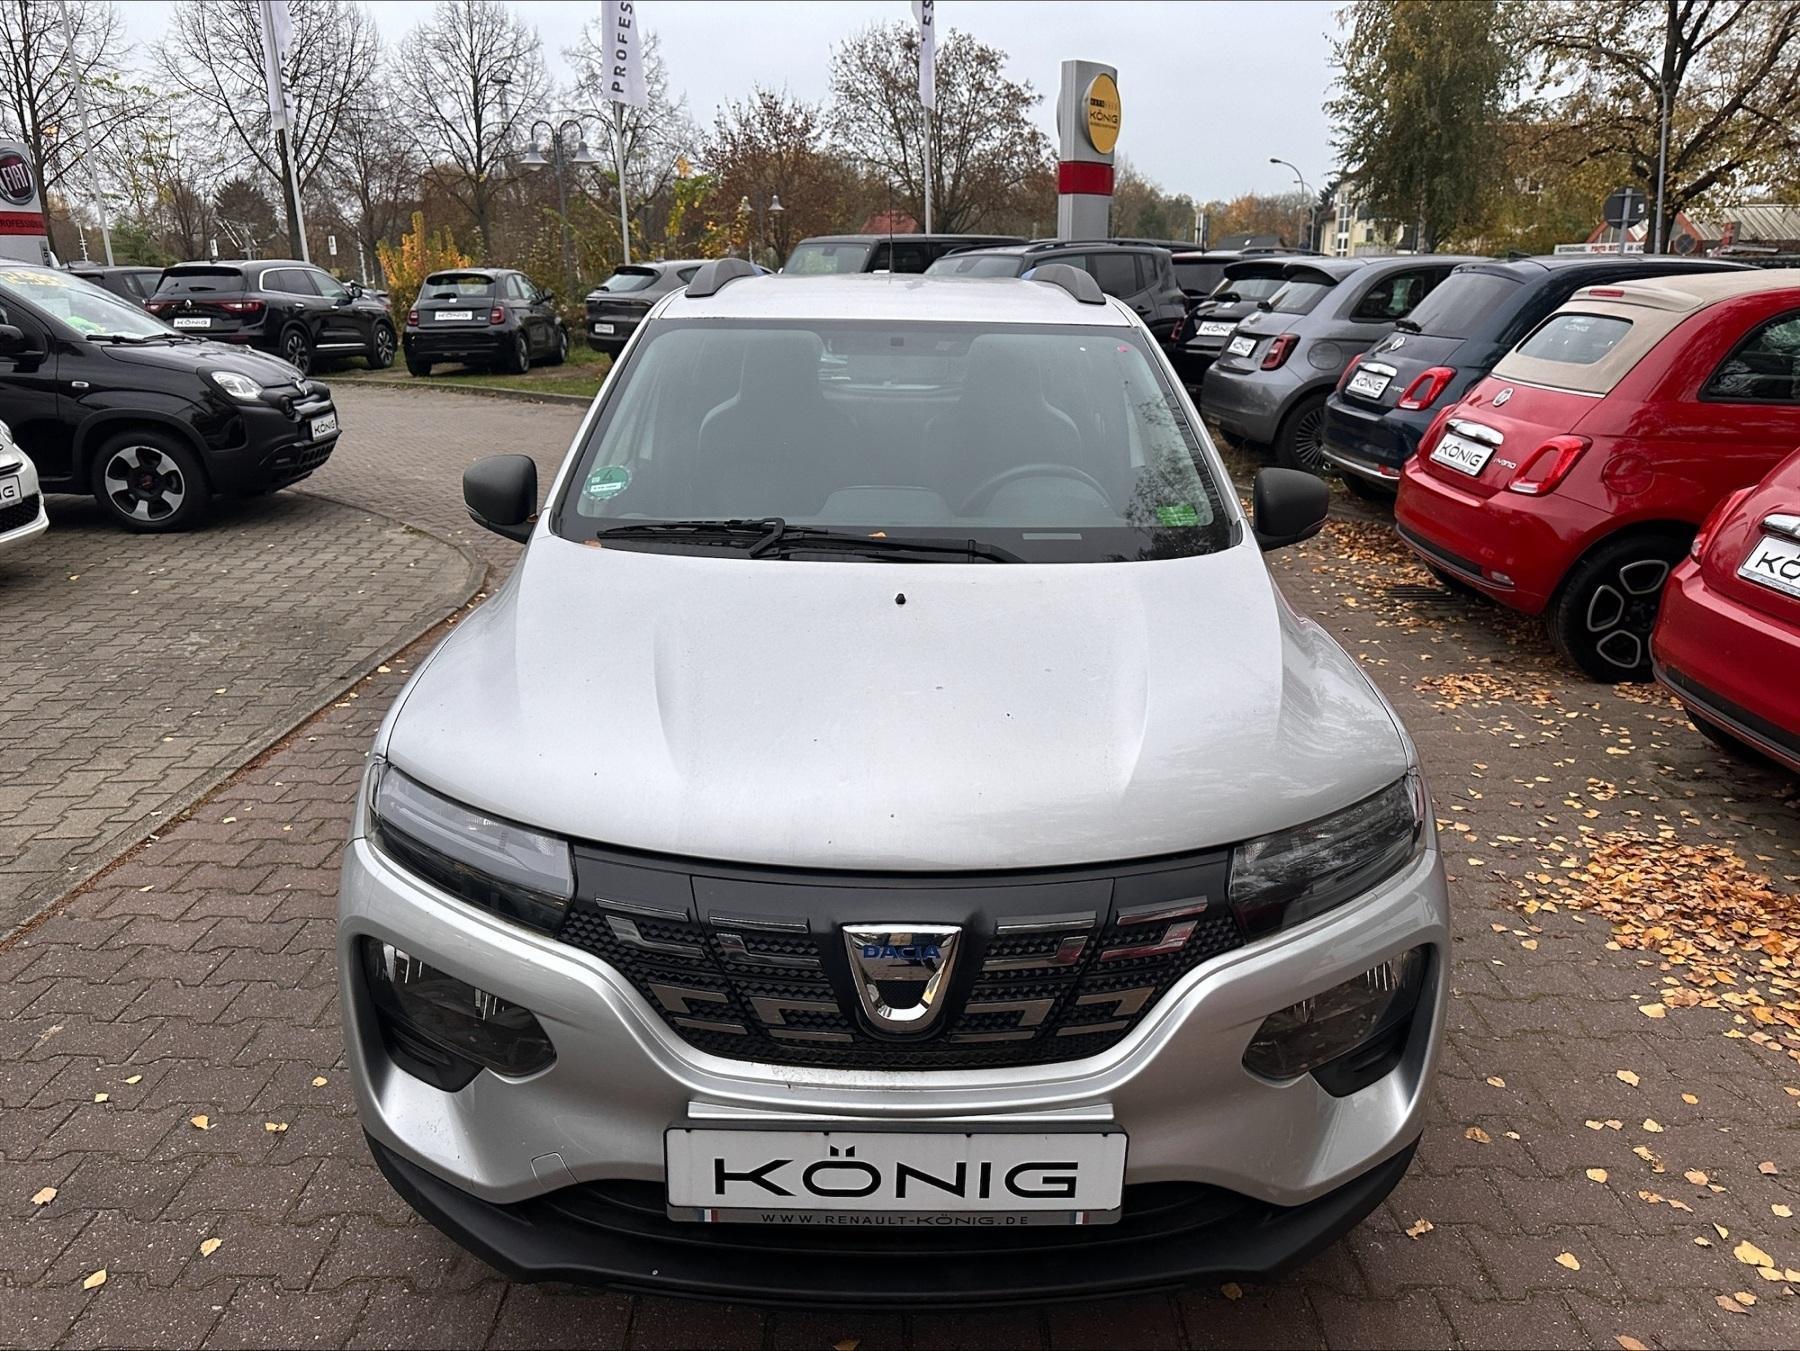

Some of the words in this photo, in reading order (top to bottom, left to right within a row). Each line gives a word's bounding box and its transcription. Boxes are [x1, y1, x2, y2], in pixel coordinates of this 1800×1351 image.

[1089, 109, 1118, 124] KÖNIG
[1, 163, 28, 192] FIAT
[1354, 375, 1384, 391] KÖNIG
[314, 419, 335, 435] KÖNIG
[1439, 442, 1482, 467] KÖNIG
[863, 944, 941, 959] DACIA
[714, 1145, 1079, 1199] KÖNIG
[761, 1213, 1029, 1225] WWW.RENAULT-KÖNIG.DE
